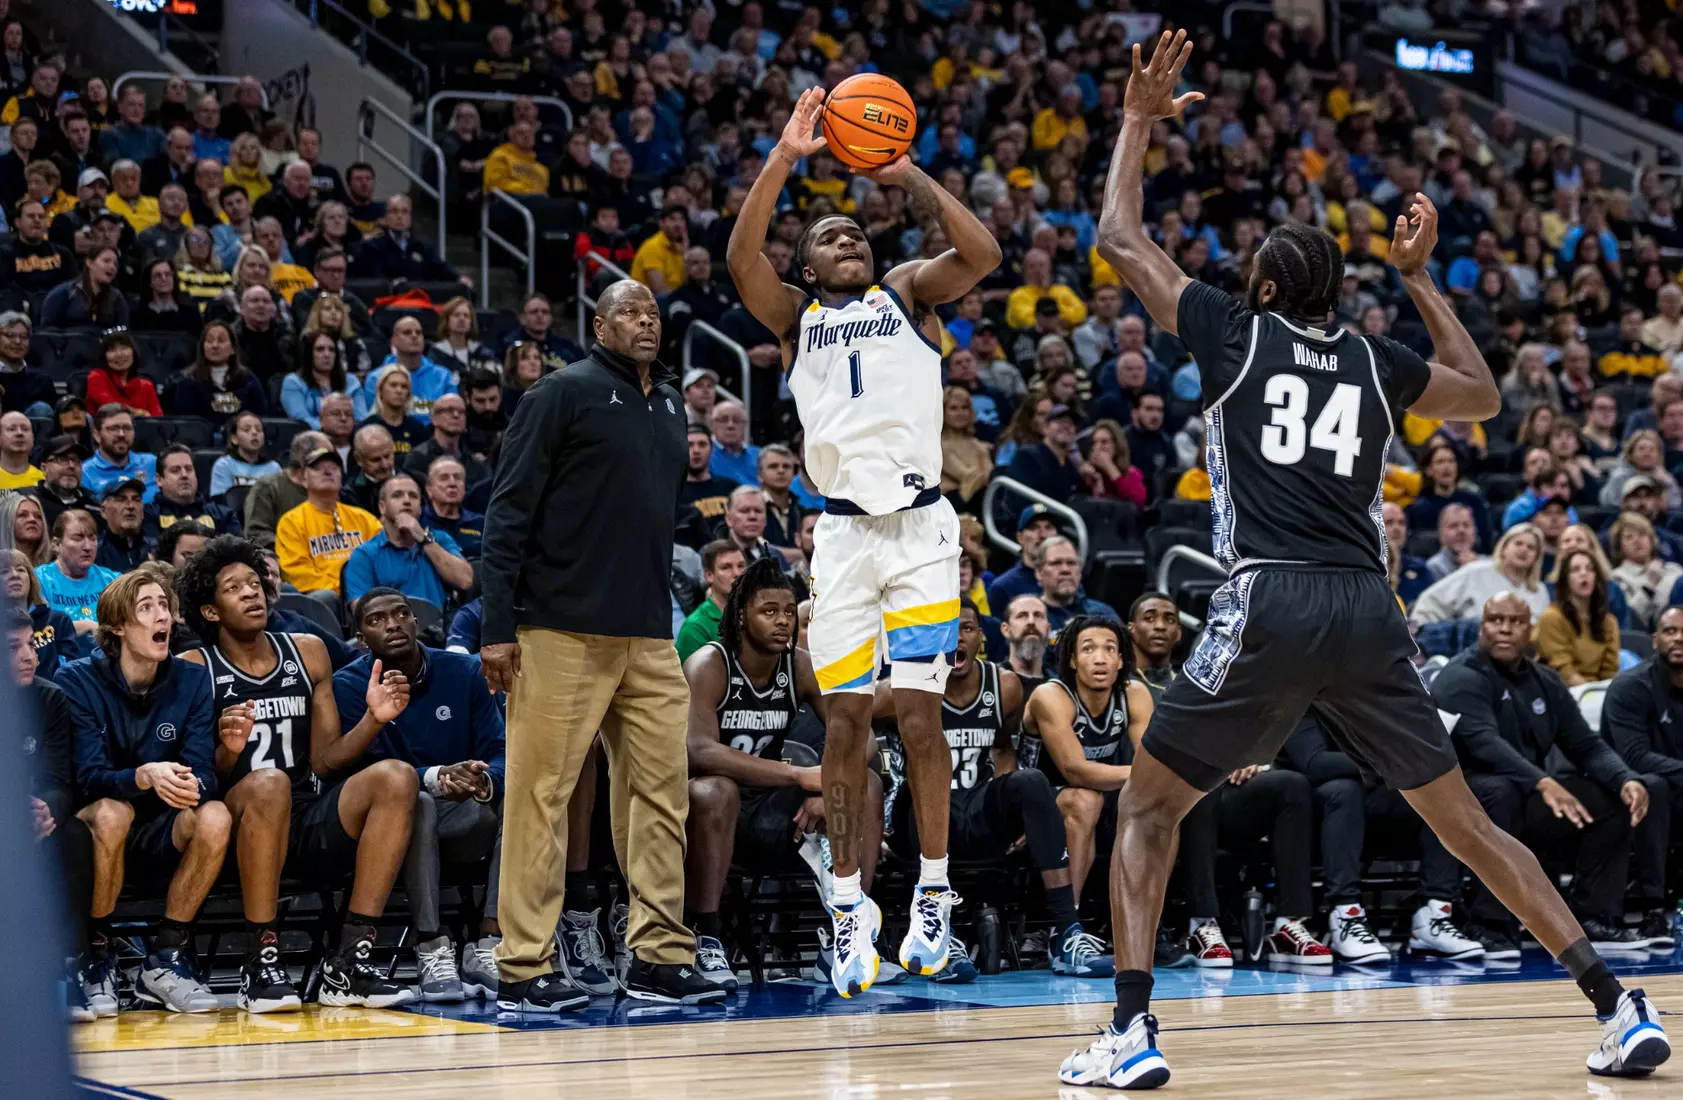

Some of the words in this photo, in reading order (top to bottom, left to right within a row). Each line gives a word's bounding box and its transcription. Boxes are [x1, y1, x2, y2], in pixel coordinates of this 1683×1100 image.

[863, 107, 909, 134] ELITE
[804, 312, 903, 353] Marquette
[848, 350, 864, 398] 1
[1292, 342, 1338, 371] WAHAB
[1260, 373, 1363, 477] 34
[247, 718, 295, 772] 21
[944, 728, 996, 748] RGETOWN
